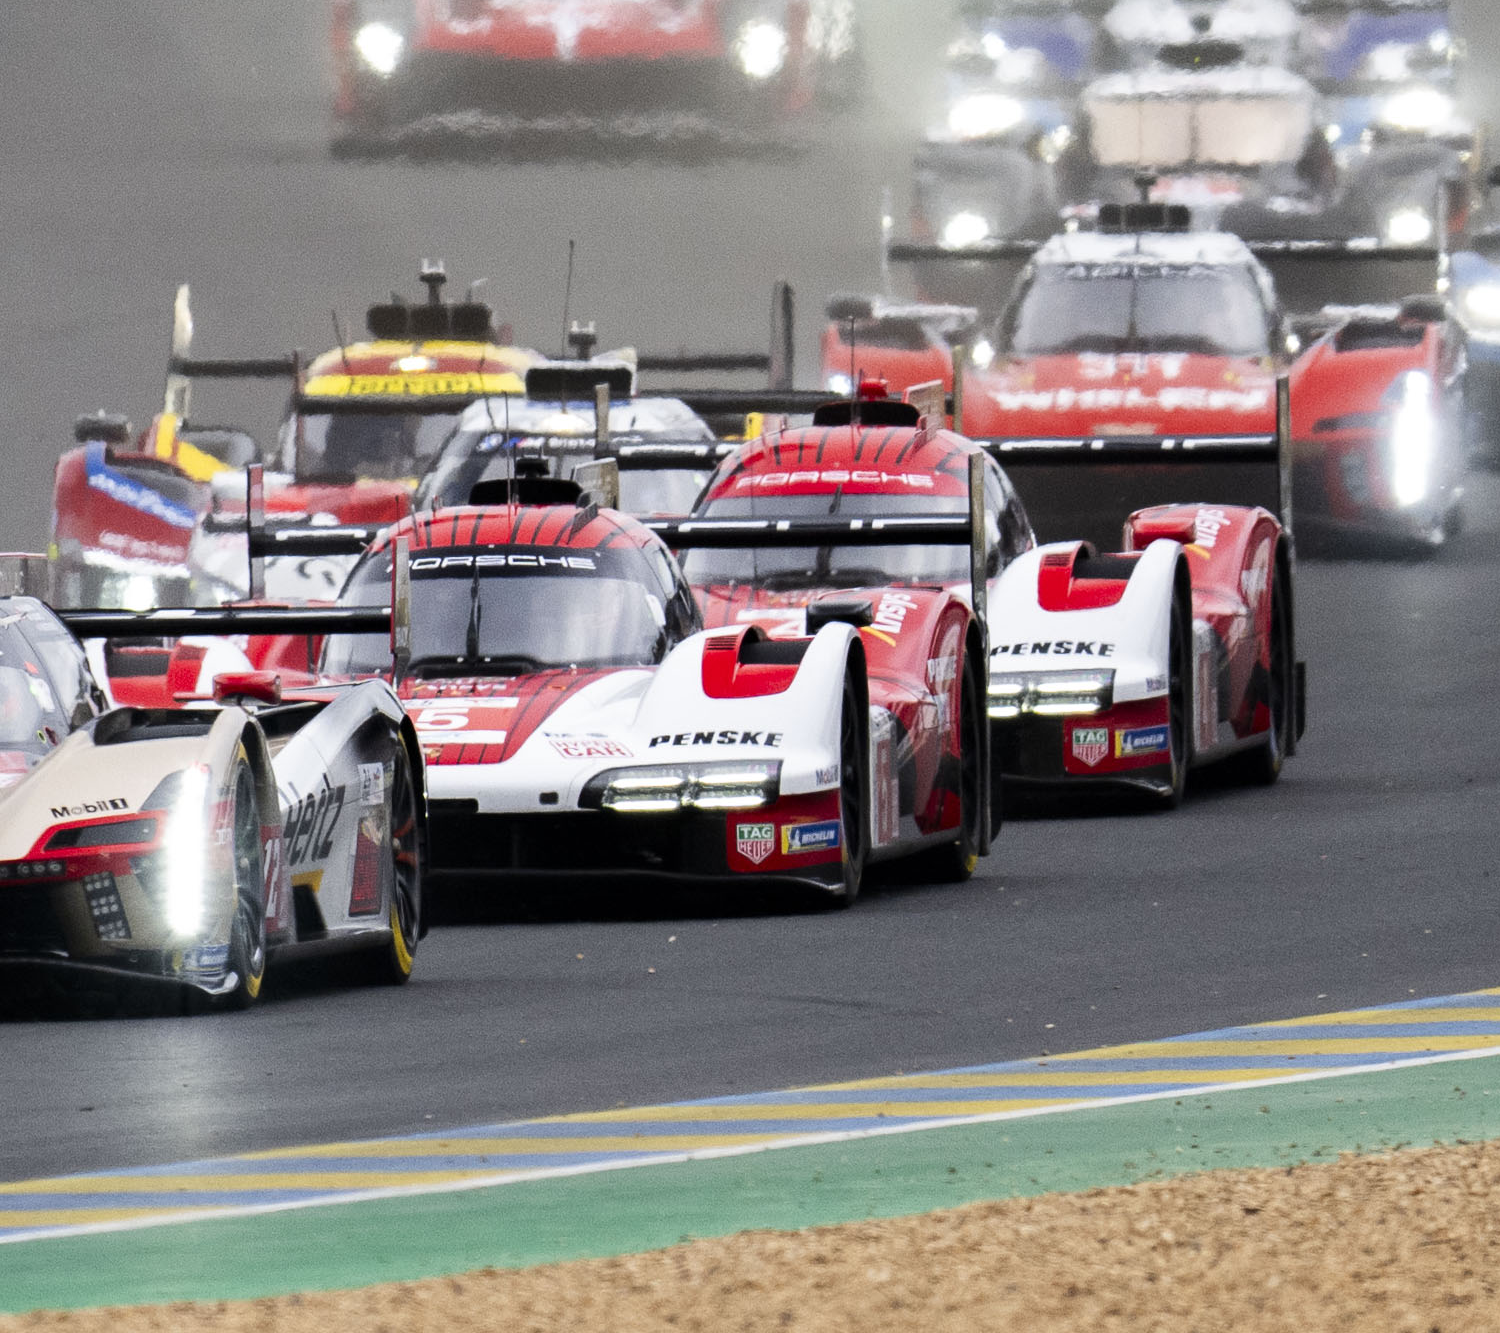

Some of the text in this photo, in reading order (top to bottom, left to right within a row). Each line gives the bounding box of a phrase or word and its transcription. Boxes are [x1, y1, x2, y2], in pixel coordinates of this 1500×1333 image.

[735, 469, 935, 489] PORSCHE
[386, 554, 598, 574] ORSCHE
[989, 639, 1116, 658] PENSKE
[416, 707, 470, 730] 5
[648, 730, 784, 749] PENSKE
[562, 747, 627, 758] CAR
[739, 827, 773, 839] TAG
[801, 829, 836, 844] MICHELIN
[738, 840, 773, 862] HEUER
